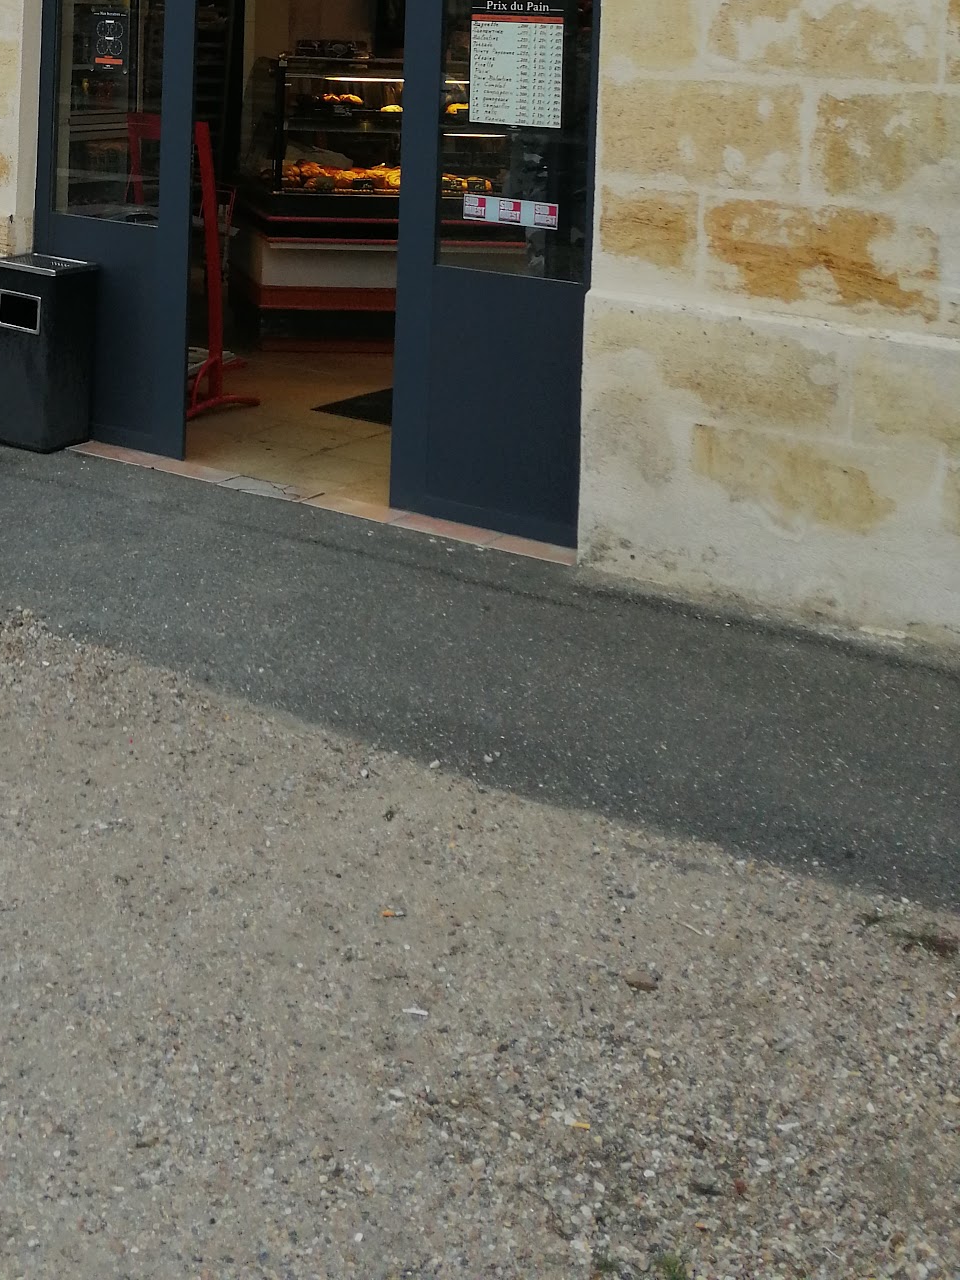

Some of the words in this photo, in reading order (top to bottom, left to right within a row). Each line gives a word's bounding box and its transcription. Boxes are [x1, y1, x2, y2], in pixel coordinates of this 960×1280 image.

[486, 0, 508, 10] Prix
[510, 1, 524, 11] du
[526, 2, 550, 12] Pain
